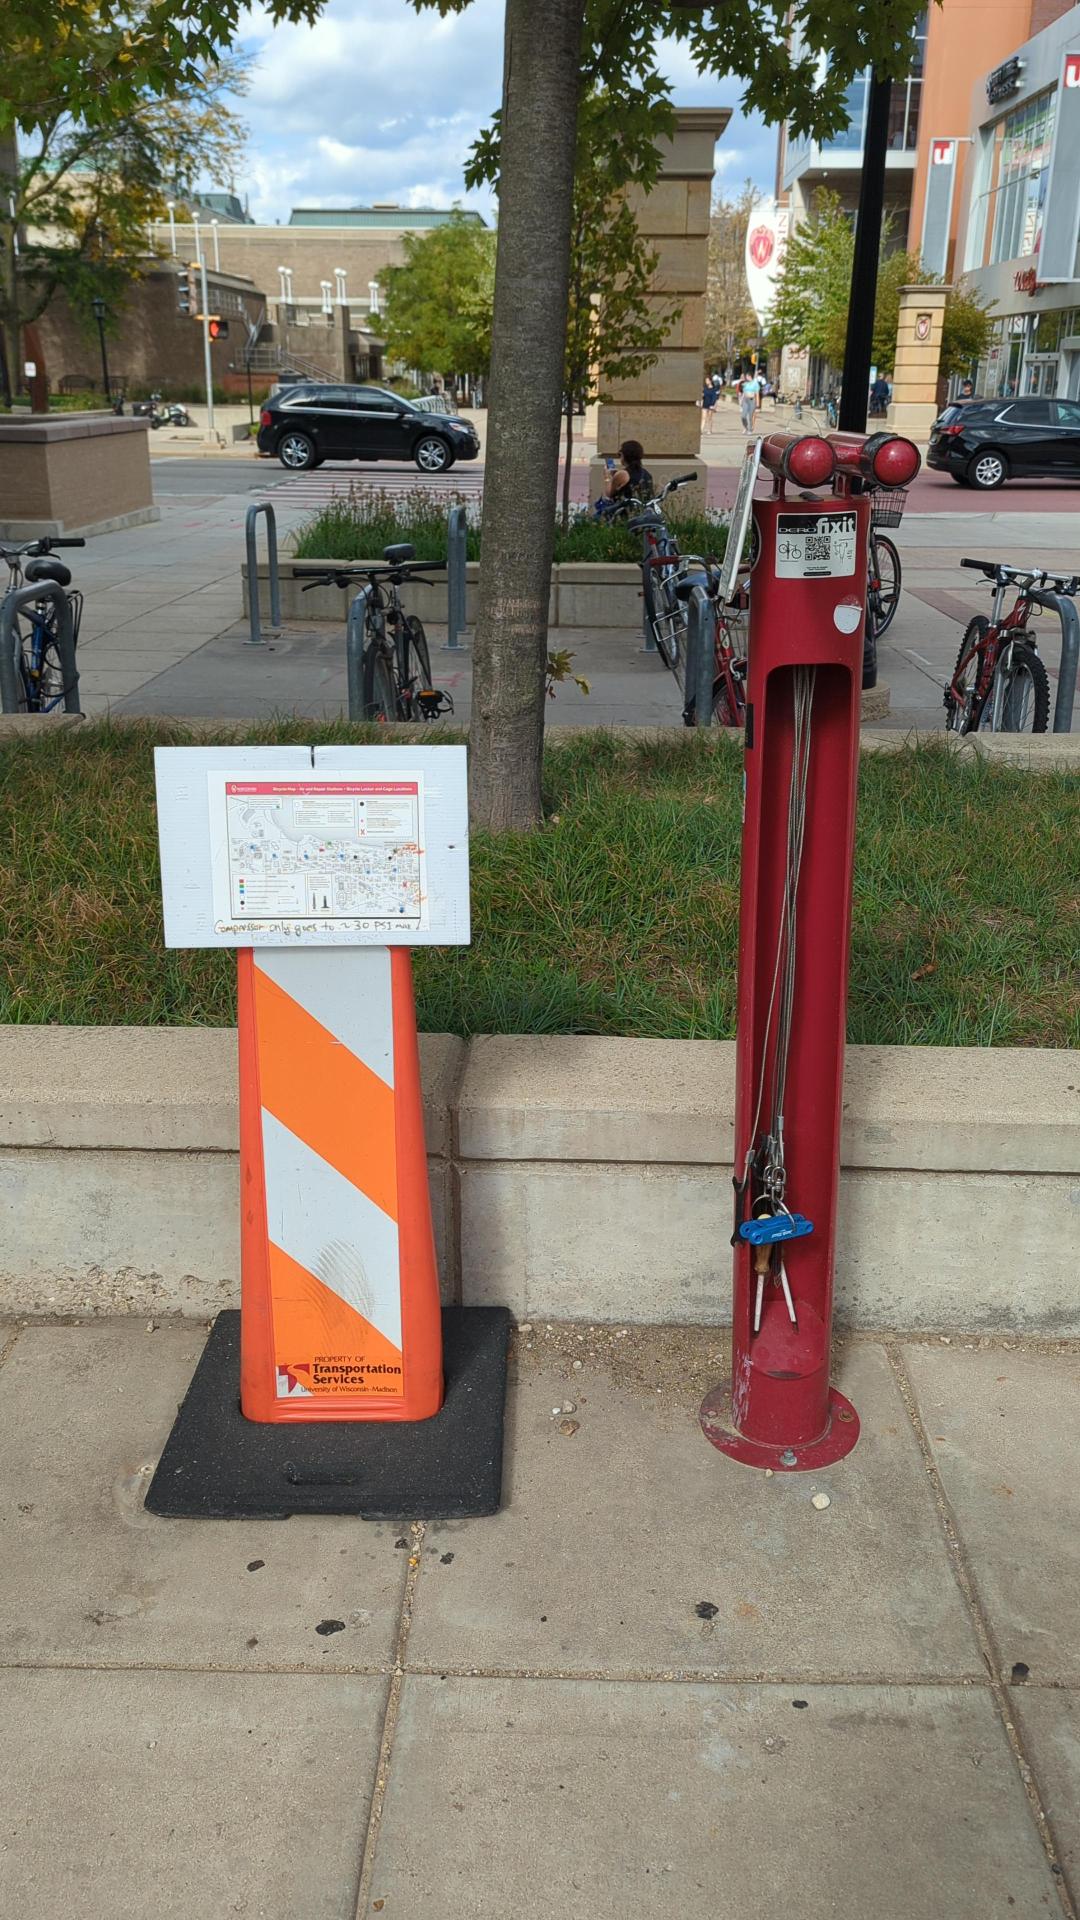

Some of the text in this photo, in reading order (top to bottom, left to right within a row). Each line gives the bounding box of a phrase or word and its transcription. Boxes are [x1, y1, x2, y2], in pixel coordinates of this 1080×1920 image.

[816, 516, 855, 534] fixit
[321, 921, 335, 931] to
[374, 921, 392, 931] PSI
[312, 1363, 401, 1375] Transportation
[313, 1374, 364, 1384] Services
[301, 1385, 331, 1393] University
